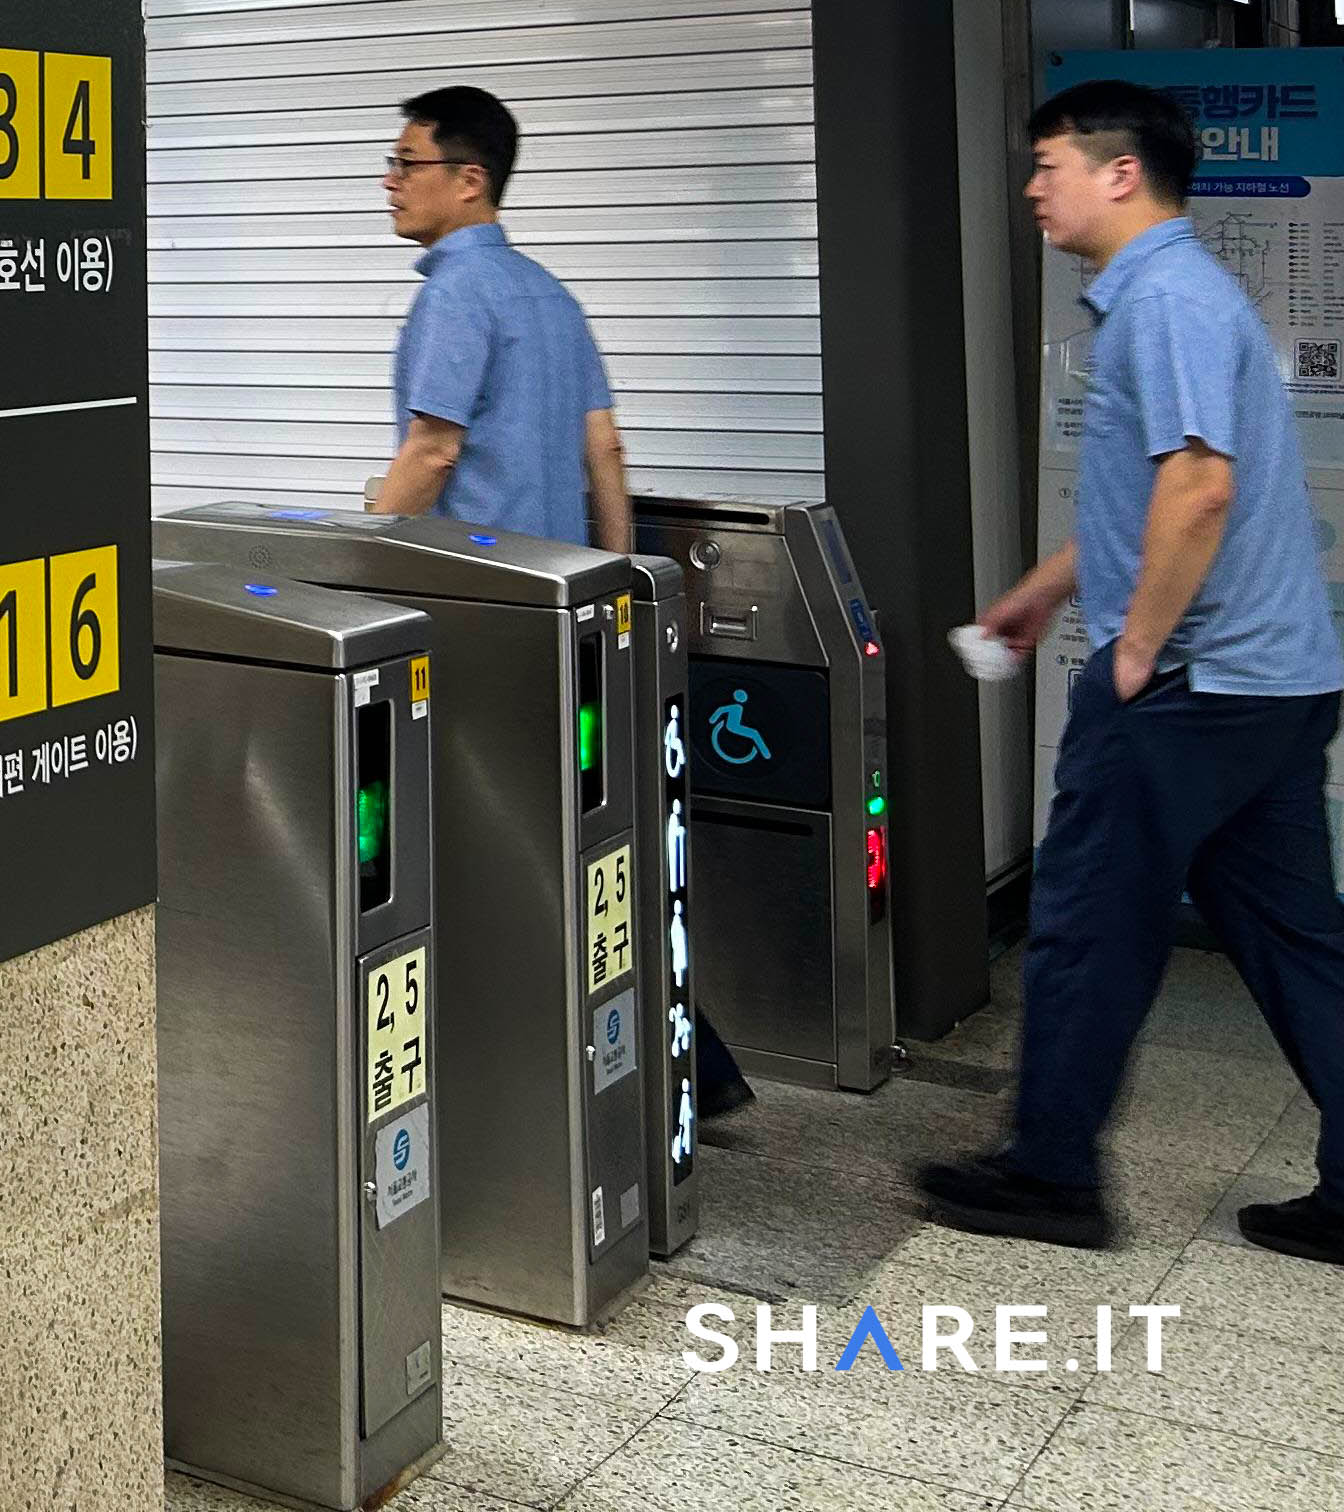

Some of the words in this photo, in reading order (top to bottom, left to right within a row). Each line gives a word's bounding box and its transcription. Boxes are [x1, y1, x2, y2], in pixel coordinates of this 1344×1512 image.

[62, 80, 96, 180] 4
[1201, 126, 1279, 161] 안내
[55, 235, 113, 292] 이용)
[69, 572, 102, 681] 6
[415, 666, 426, 691] 11
[31, 734, 89, 784] 게이트
[94, 715, 139, 766] 이용)
[616, 854, 626, 903] 5
[405, 959, 418, 1016] 5
